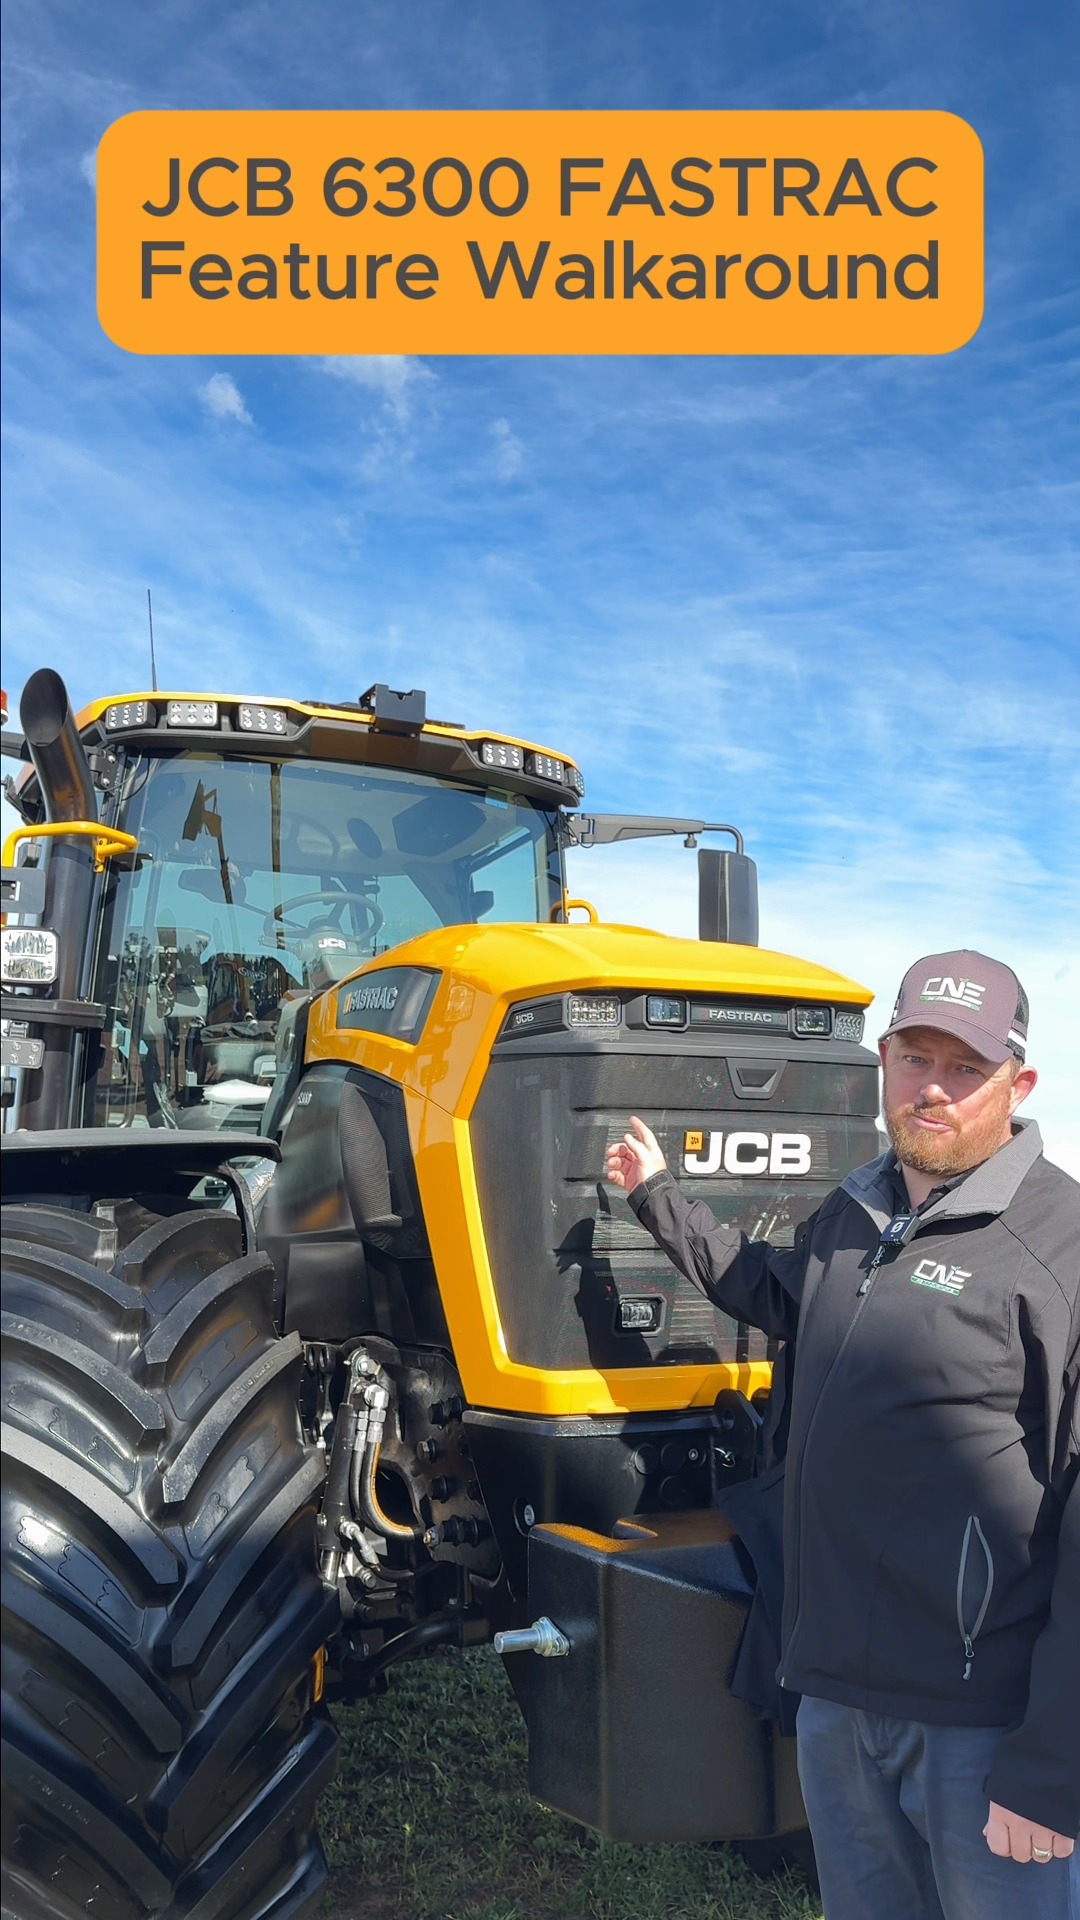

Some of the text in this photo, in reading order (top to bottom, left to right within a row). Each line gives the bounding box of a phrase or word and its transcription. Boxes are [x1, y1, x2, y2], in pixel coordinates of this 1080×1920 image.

[318, 937, 347, 950] JCB
[350, 985, 399, 1011] FASTRAC
[921, 977, 986, 1006] CNE
[515, 1012, 535, 1025] JCB
[708, 1009, 773, 1023] FASTRAC
[683, 1131, 812, 1175] JCB
[913, 1259, 973, 1290] CNE
